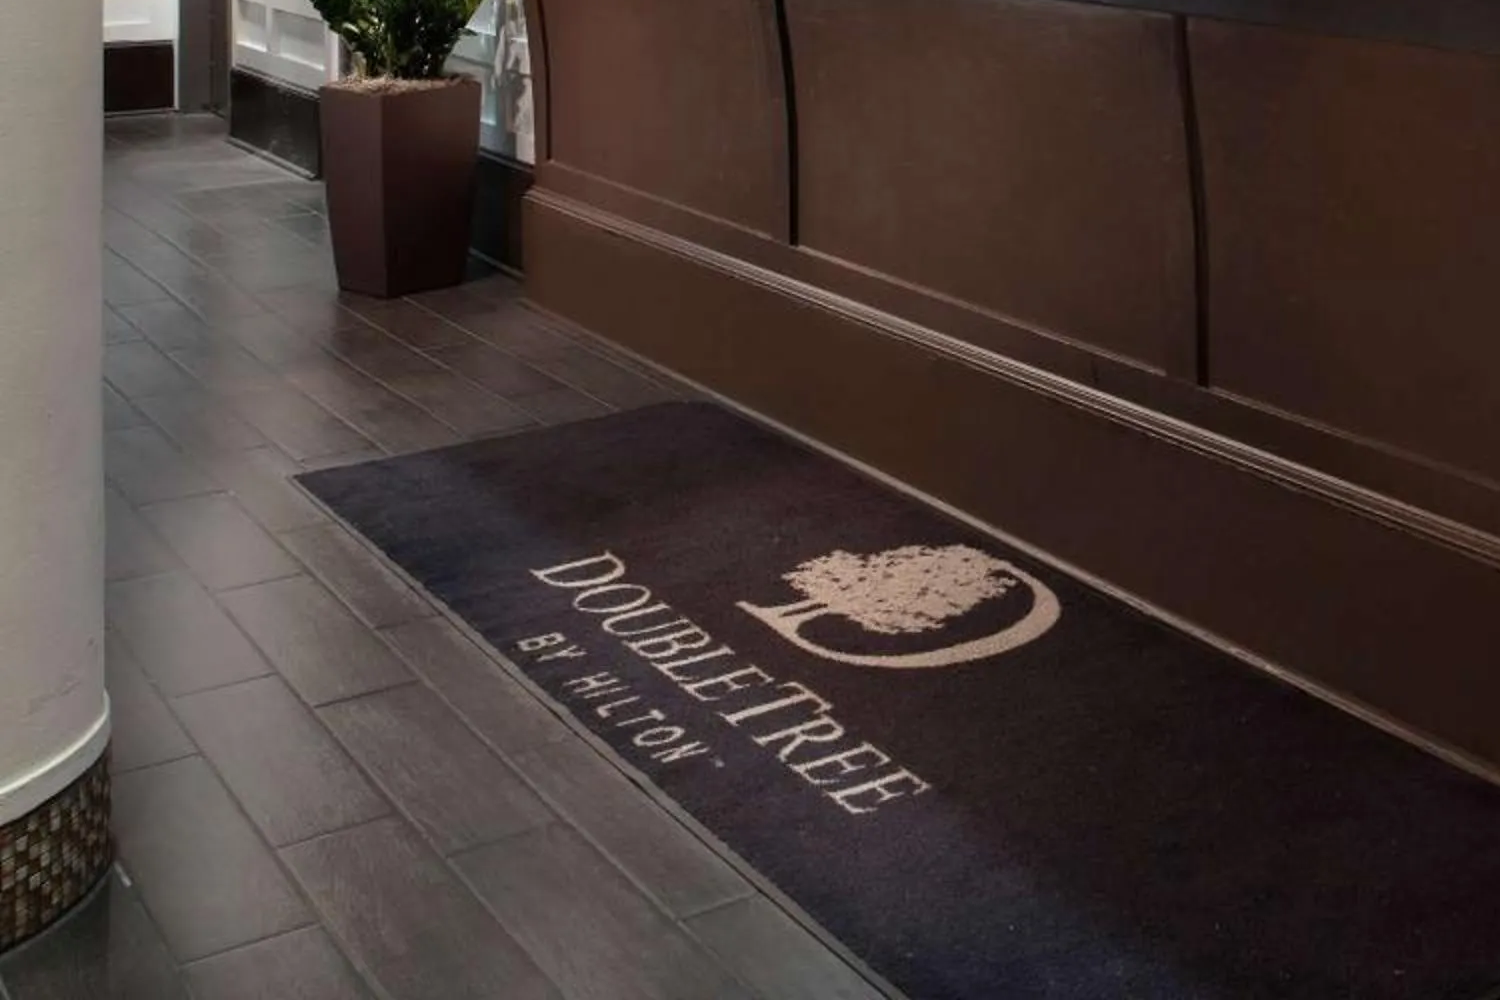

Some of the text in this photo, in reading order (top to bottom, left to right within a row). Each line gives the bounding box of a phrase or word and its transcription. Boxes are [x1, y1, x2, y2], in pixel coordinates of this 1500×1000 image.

[516, 631, 711, 764] BY HILTON
[529, 549, 932, 815] DOUBLETREE
